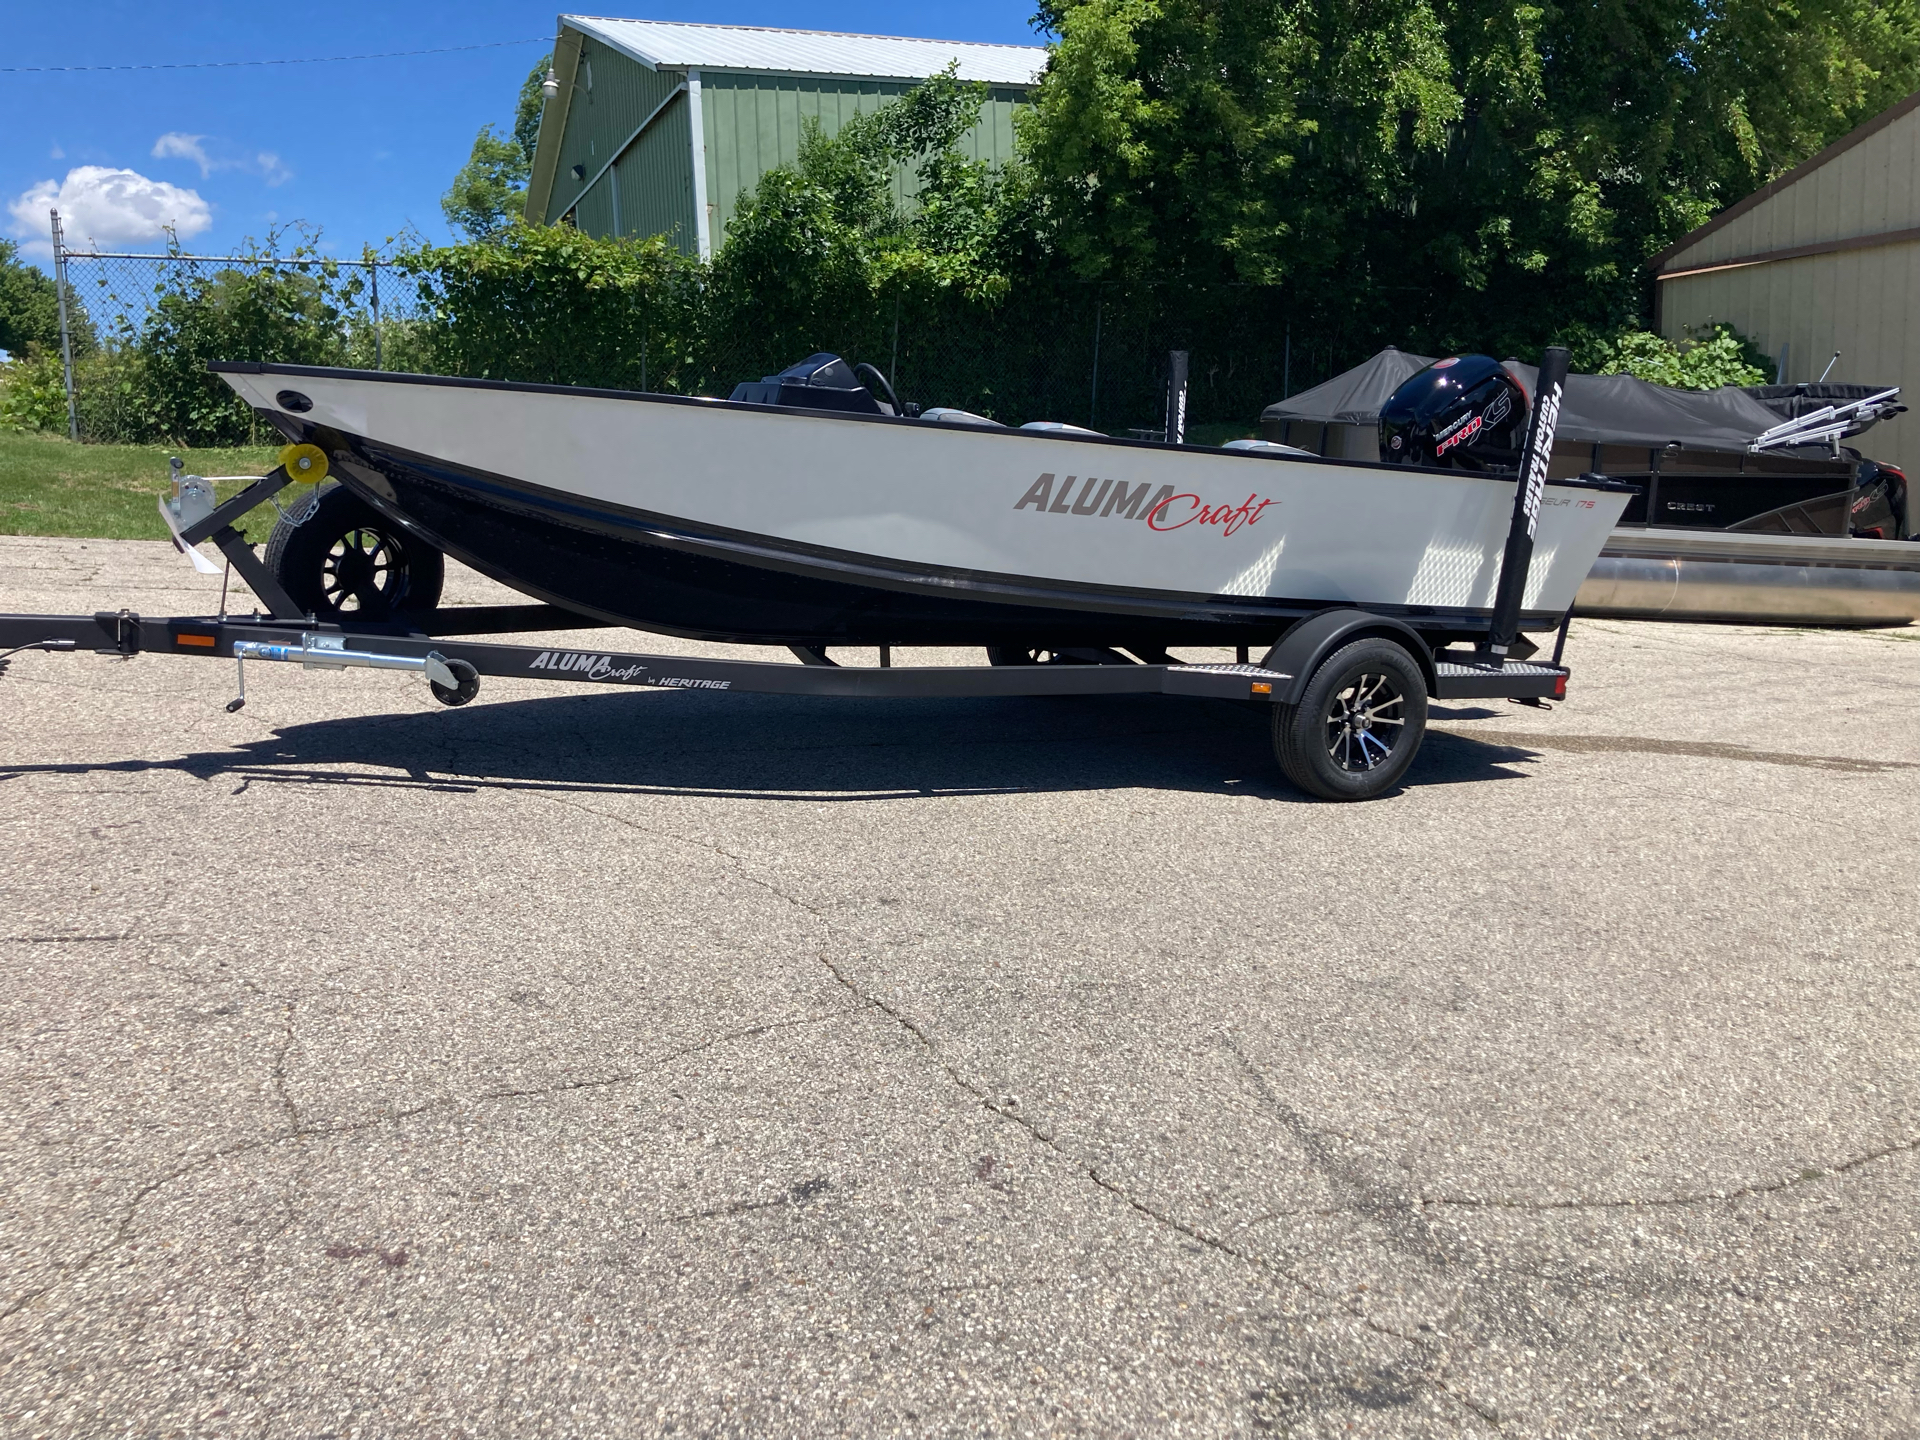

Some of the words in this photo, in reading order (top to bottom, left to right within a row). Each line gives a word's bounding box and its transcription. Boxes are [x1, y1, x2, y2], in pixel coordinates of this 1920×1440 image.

[1435, 410, 1472, 441] MERCURY
[1436, 416, 1482, 457] PRO
[1467, 387, 1512, 447] XS
[1533, 394, 1550, 452] CUSTOM
[1527, 381, 1563, 542] HERITAGE
[1523, 453, 1540, 517] TRAILERS
[1575, 499, 1596, 509] 175
[1667, 501, 1716, 513] CREST
[658, 677, 732, 690] HERITAGE
